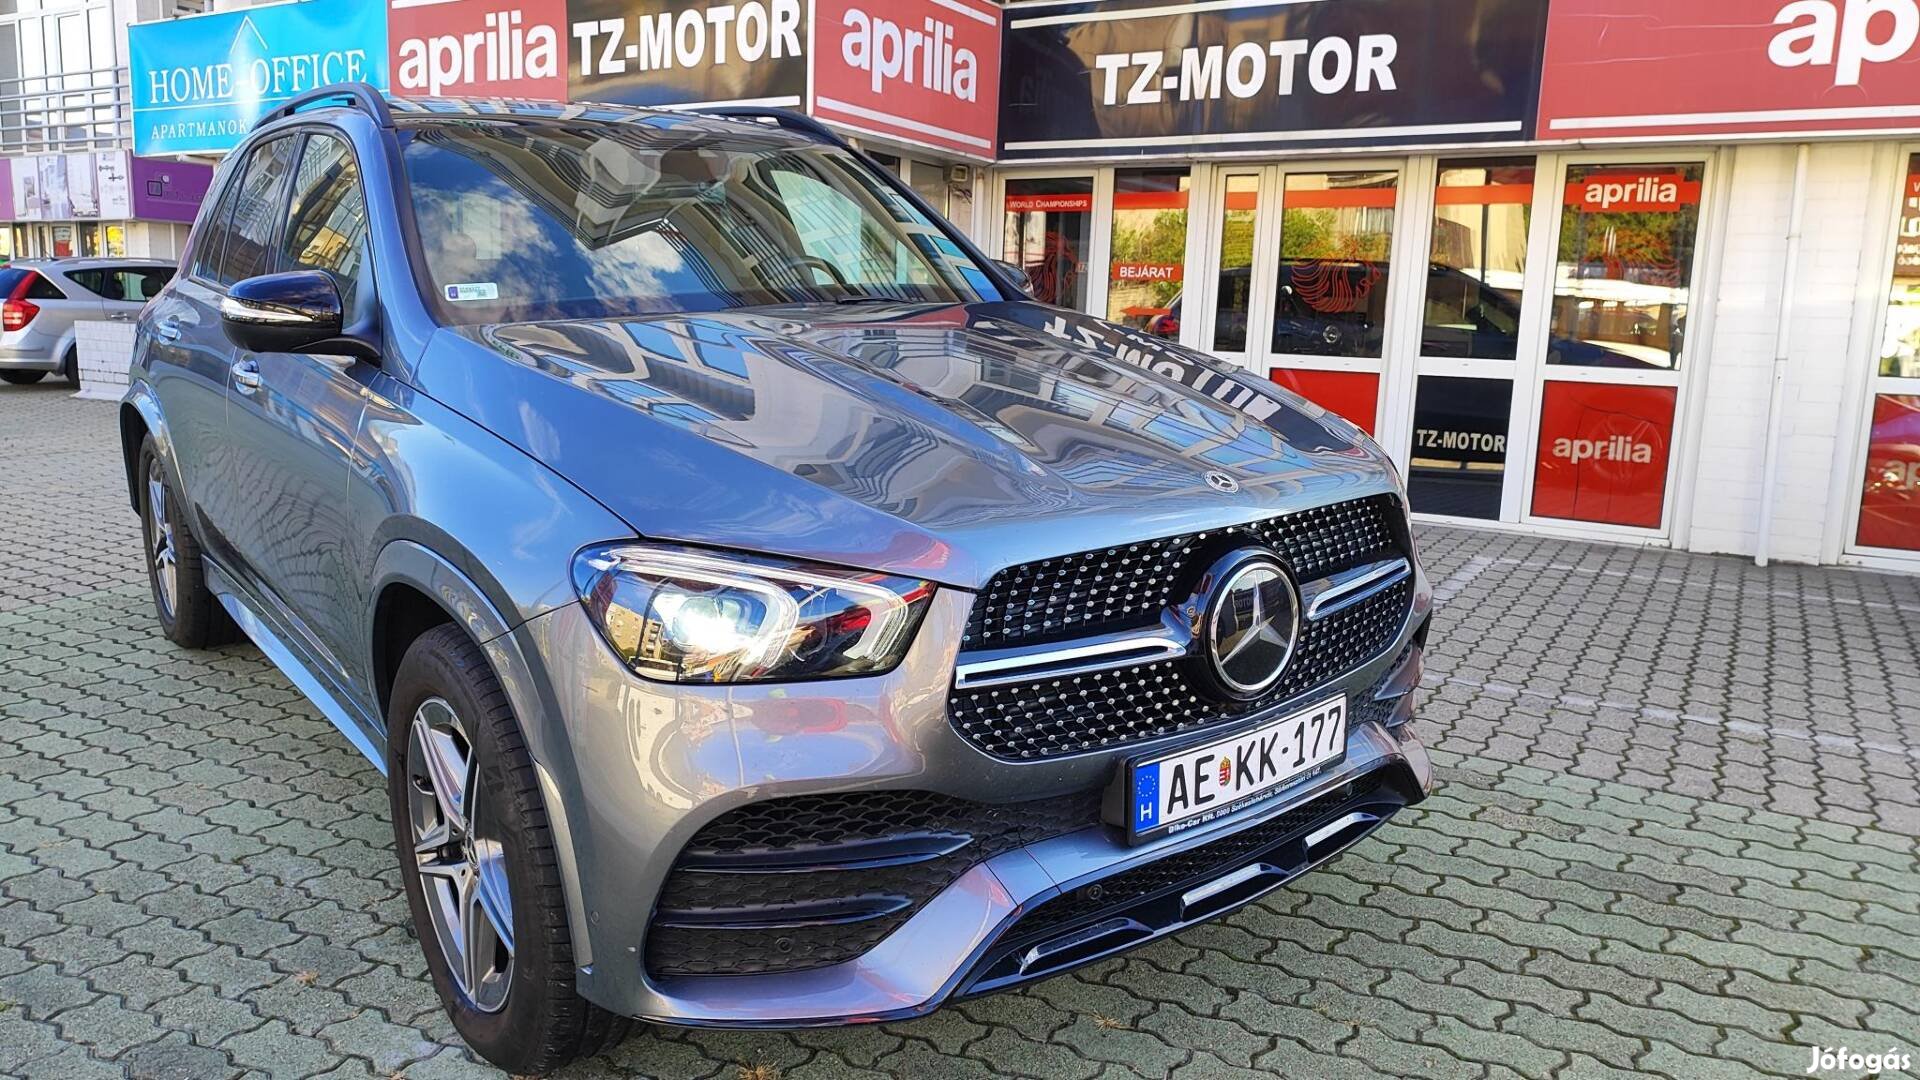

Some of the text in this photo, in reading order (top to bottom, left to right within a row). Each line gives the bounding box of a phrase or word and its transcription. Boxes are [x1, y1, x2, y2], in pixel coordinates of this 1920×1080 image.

[398, 9, 558, 97] aprilia
[572, 0, 802, 76] TZ-MOTOR
[841, 8, 977, 103] aprilia
[1095, 33, 1398, 106] TZ-MOTOR
[151, 117, 248, 140] APARTMANOK
[1009, 199, 1087, 209] WORLD CHAMPIONSHIPS
[1585, 177, 1677, 208] aprilia
[1120, 266, 1174, 279] BEJÁRAT
[1417, 429, 1506, 452] TZ-MOTOR
[1553, 435, 1651, 464] aprilia
[1236, 705, 1342, 791] KK-177
[1140, 802, 1152, 822] H
